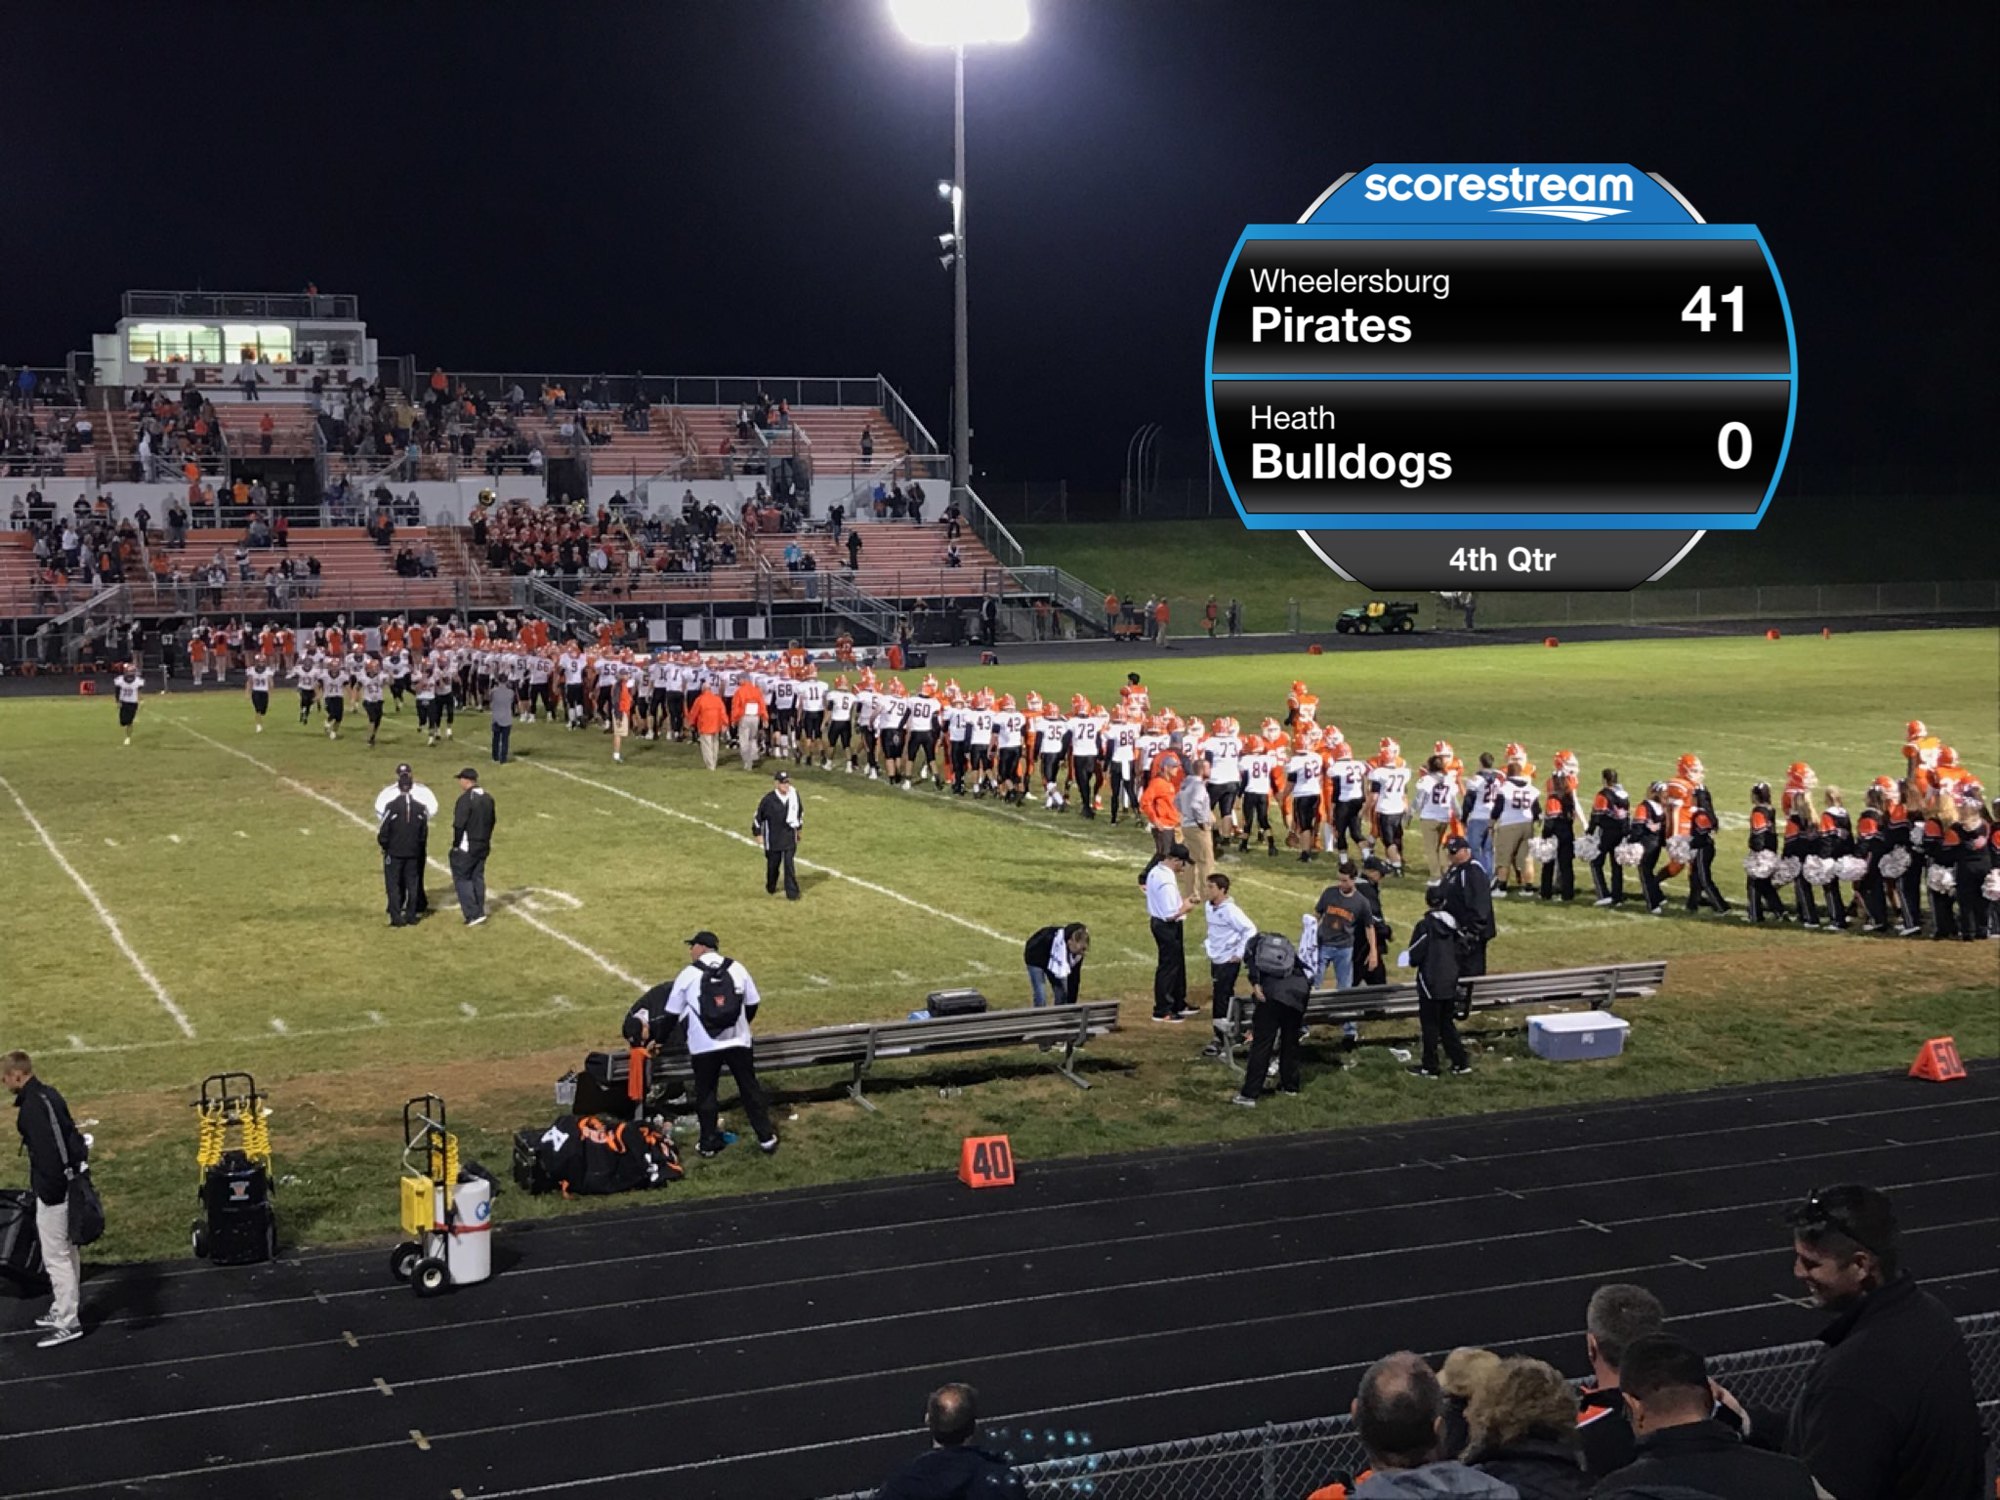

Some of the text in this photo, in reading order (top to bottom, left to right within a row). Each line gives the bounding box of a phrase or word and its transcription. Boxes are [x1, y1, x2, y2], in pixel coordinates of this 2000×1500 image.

[809, 686, 819, 701] 11
[888, 701, 905, 717] 79
[914, 702, 931, 718] 60
[978, 715, 991, 730] 43
[1007, 717, 1021, 733] 42
[1048, 725, 1062, 741] 35
[1077, 723, 1095, 740] 72
[1252, 761, 1268, 779] 84
[1304, 760, 1319, 780] 62
[1386, 774, 1405, 793] 77
[1512, 790, 1531, 809] 55
[1932, 1042, 1964, 1076] 50
[973, 1141, 1011, 1181] 40
